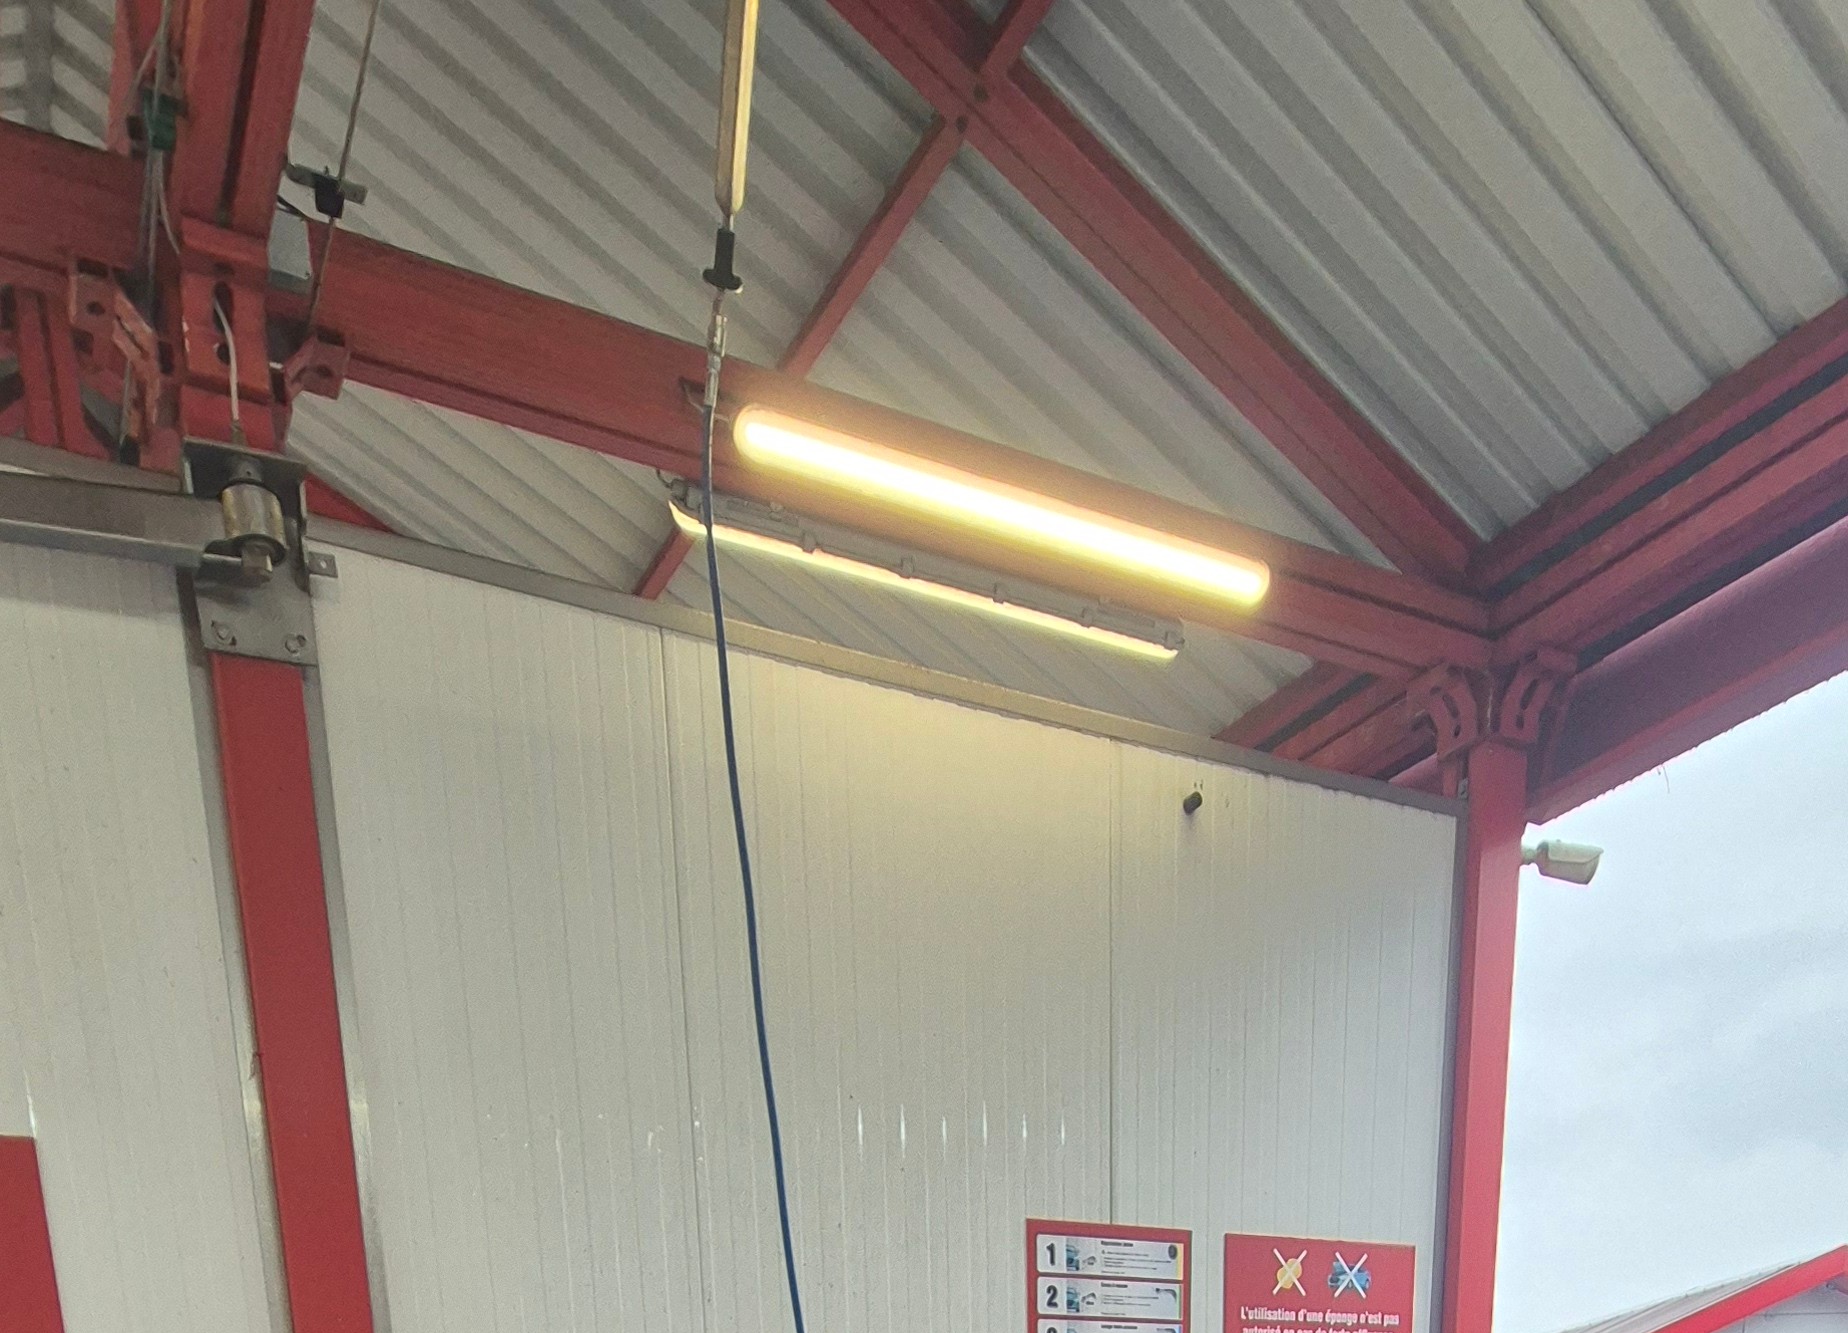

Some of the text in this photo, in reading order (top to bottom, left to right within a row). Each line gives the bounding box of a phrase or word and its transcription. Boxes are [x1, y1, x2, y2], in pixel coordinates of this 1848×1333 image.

[1046, 1242, 1056, 1267] 1
[1046, 1285, 1058, 1308] 2
[1240, 1306, 1400, 1327] L'utilisation d'une éponge n'est pas
